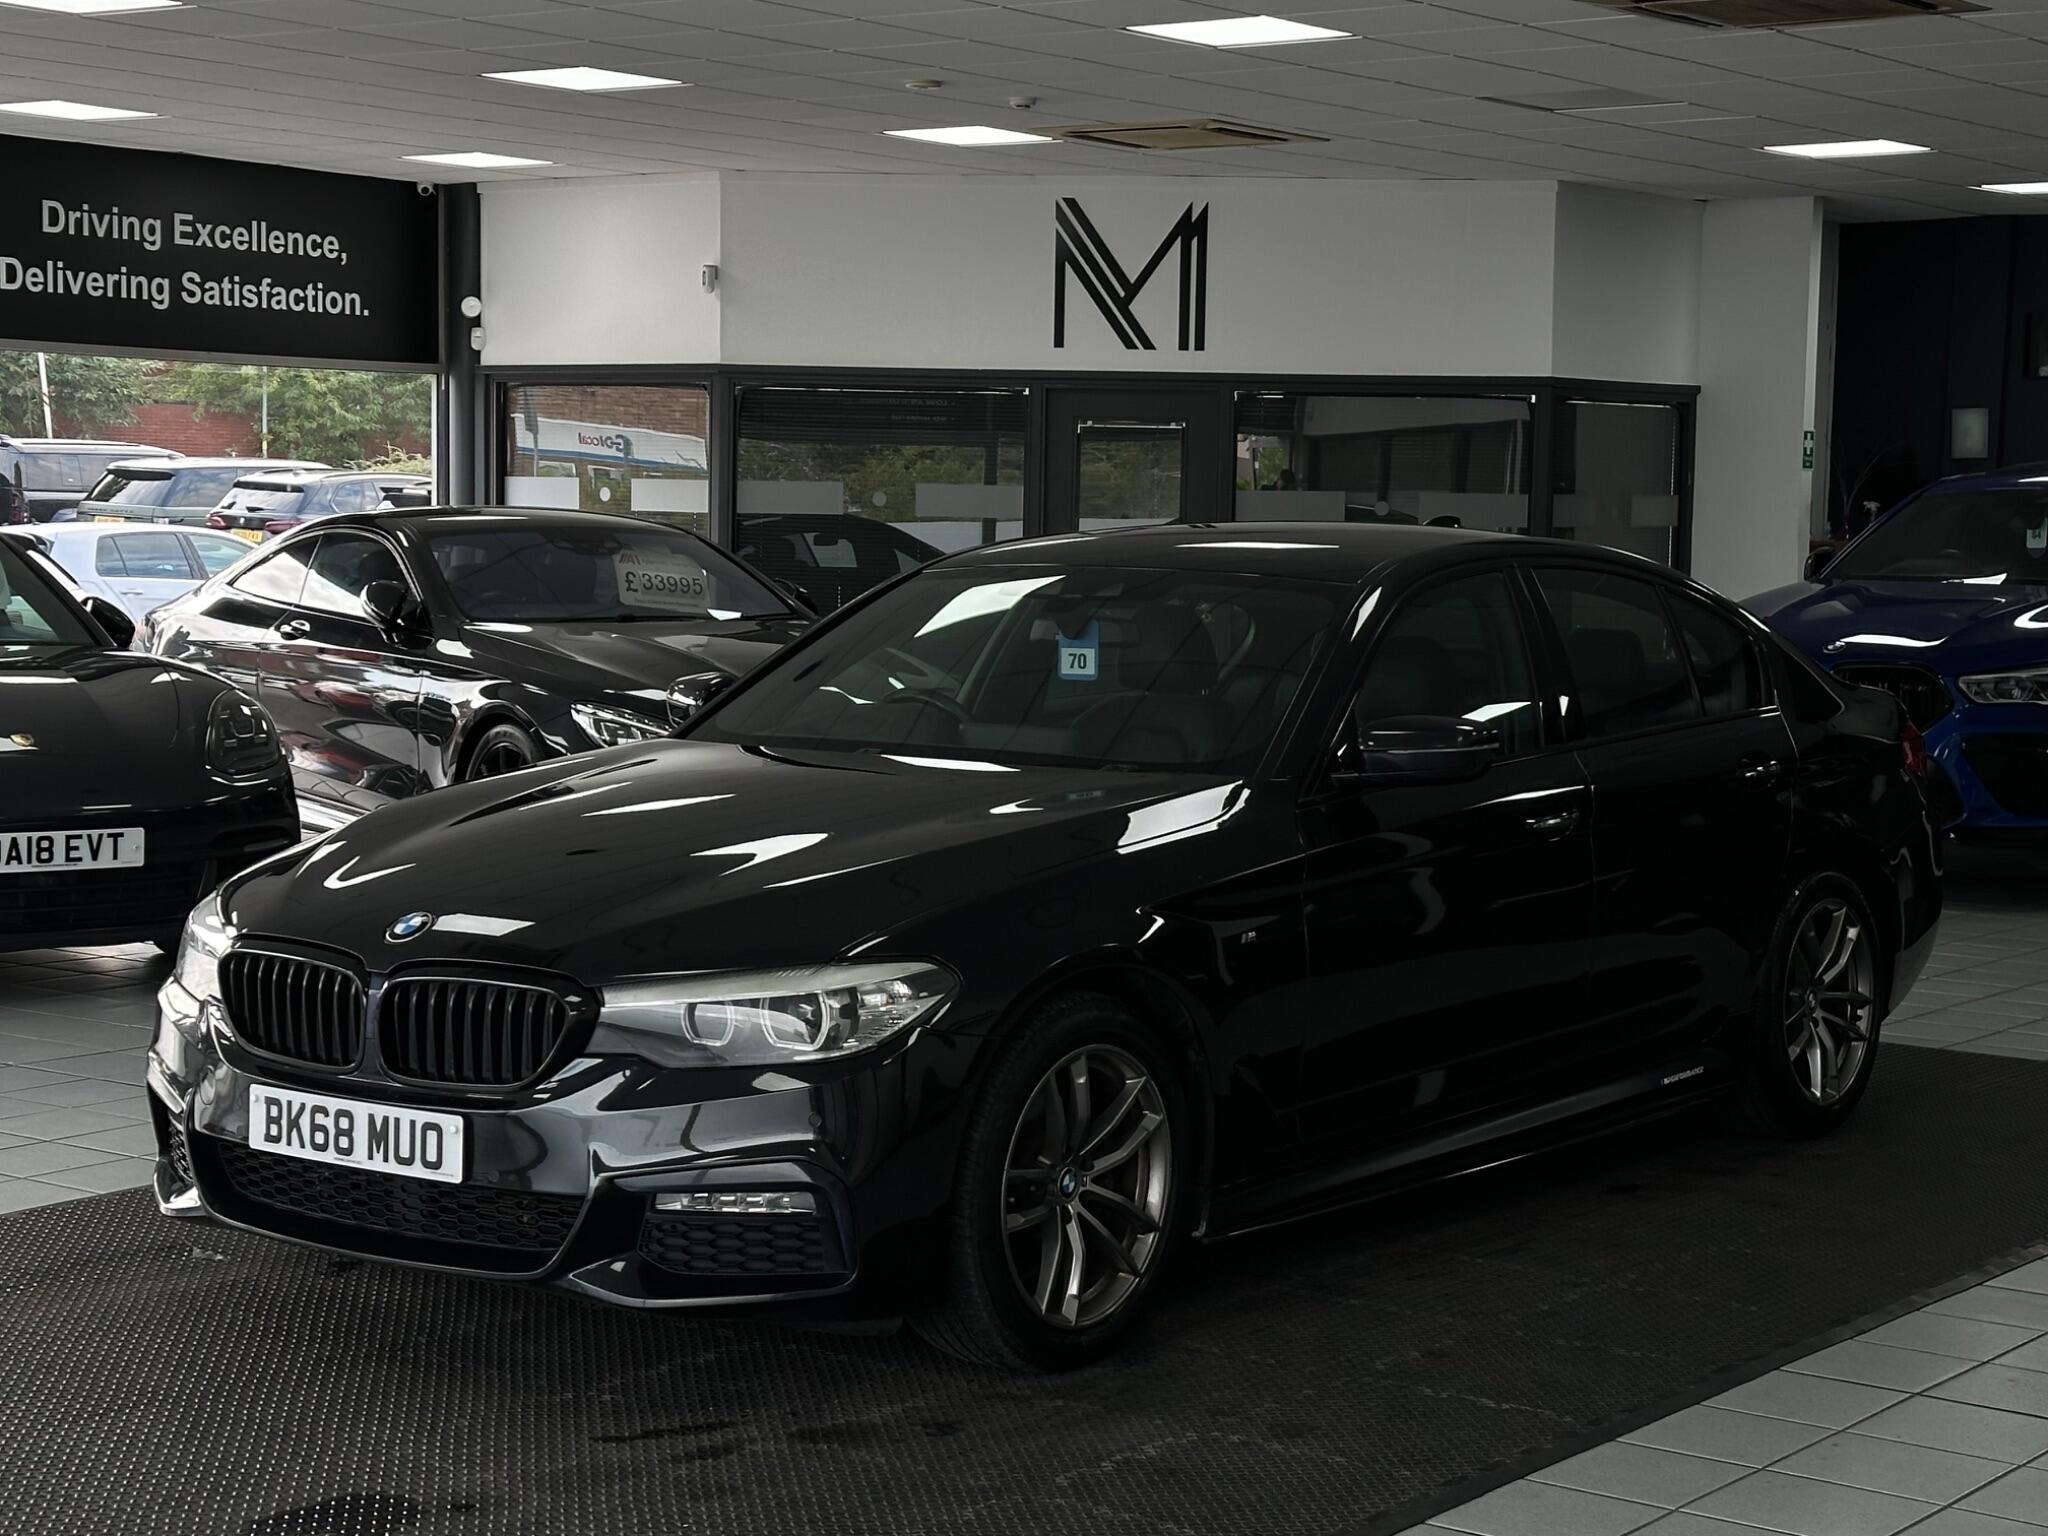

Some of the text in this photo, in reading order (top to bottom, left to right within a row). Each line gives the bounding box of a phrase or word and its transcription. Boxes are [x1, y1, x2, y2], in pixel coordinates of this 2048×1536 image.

[41, 199, 348, 265] Driving Excellence,
[0, 257, 370, 317] Delivering Satisfaction.
[1068, 652, 1087, 669] 70
[0, 832, 125, 866] A18 EVT
[264, 1096, 443, 1171] BK68 MUO
